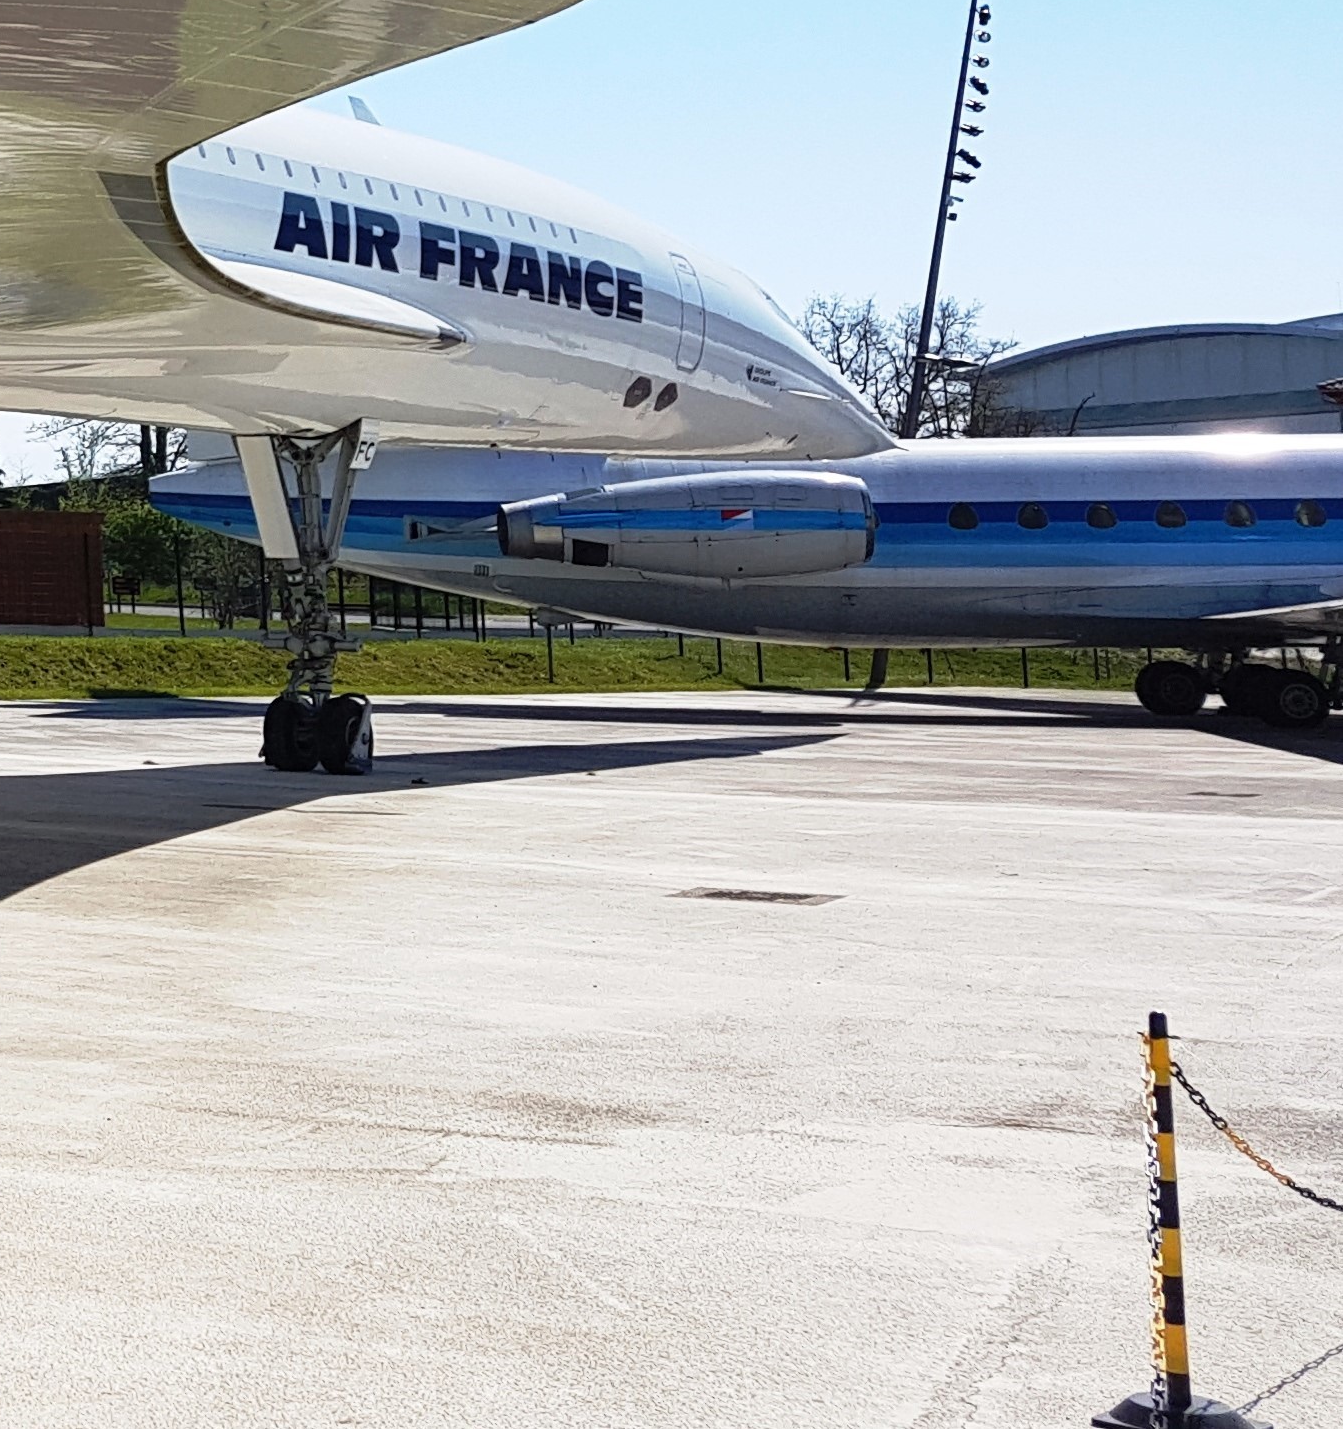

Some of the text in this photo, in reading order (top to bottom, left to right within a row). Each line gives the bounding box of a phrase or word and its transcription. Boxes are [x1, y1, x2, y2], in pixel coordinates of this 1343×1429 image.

[273, 190, 644, 324] AIR FRANCE
[354, 440, 375, 462] FC
